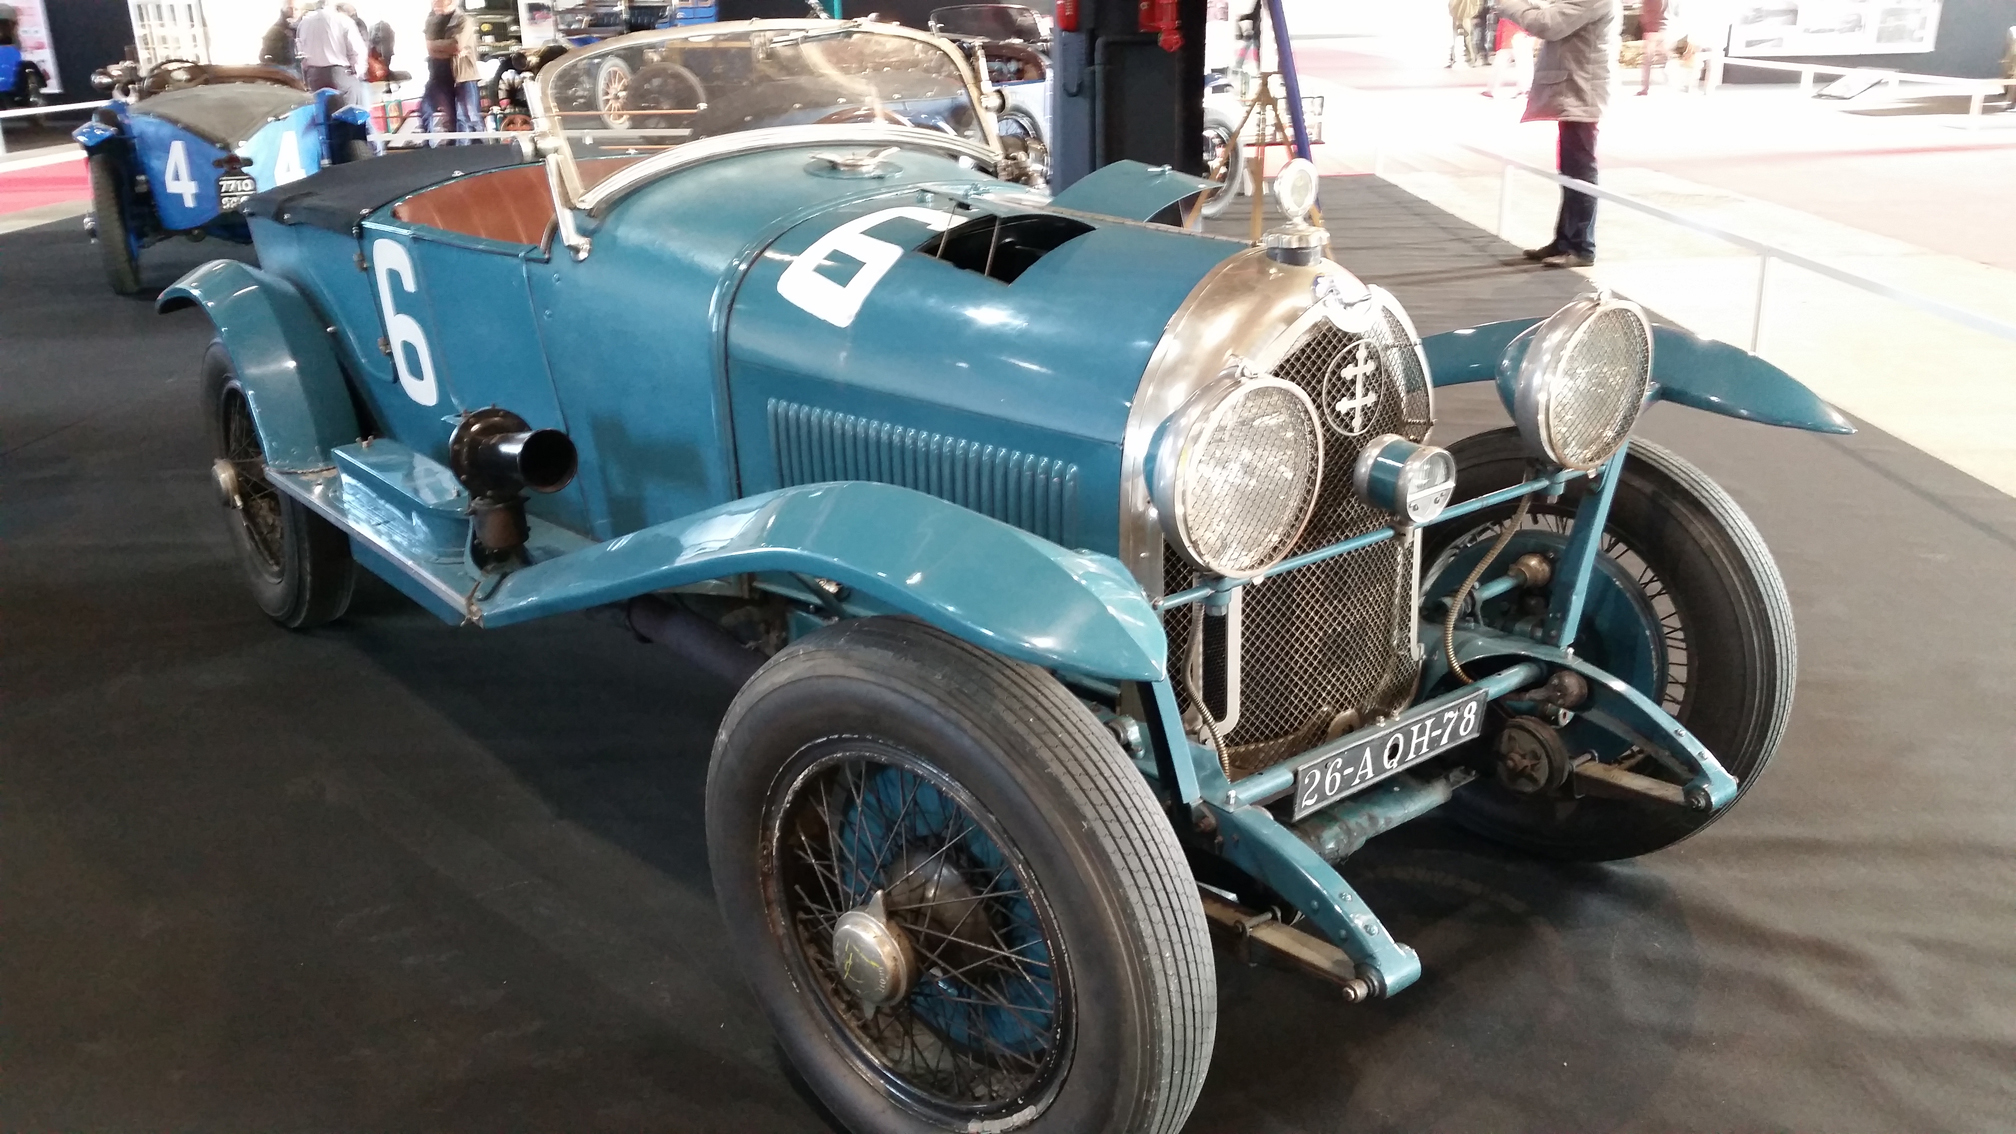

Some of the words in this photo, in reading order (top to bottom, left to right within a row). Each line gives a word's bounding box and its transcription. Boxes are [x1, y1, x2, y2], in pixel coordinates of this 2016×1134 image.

[165, 140, 199, 208] 4
[218, 179, 256, 193] 7710
[274, 130, 308, 187] 4
[776, 206, 969, 328] 6
[372, 238, 439, 407] 6
